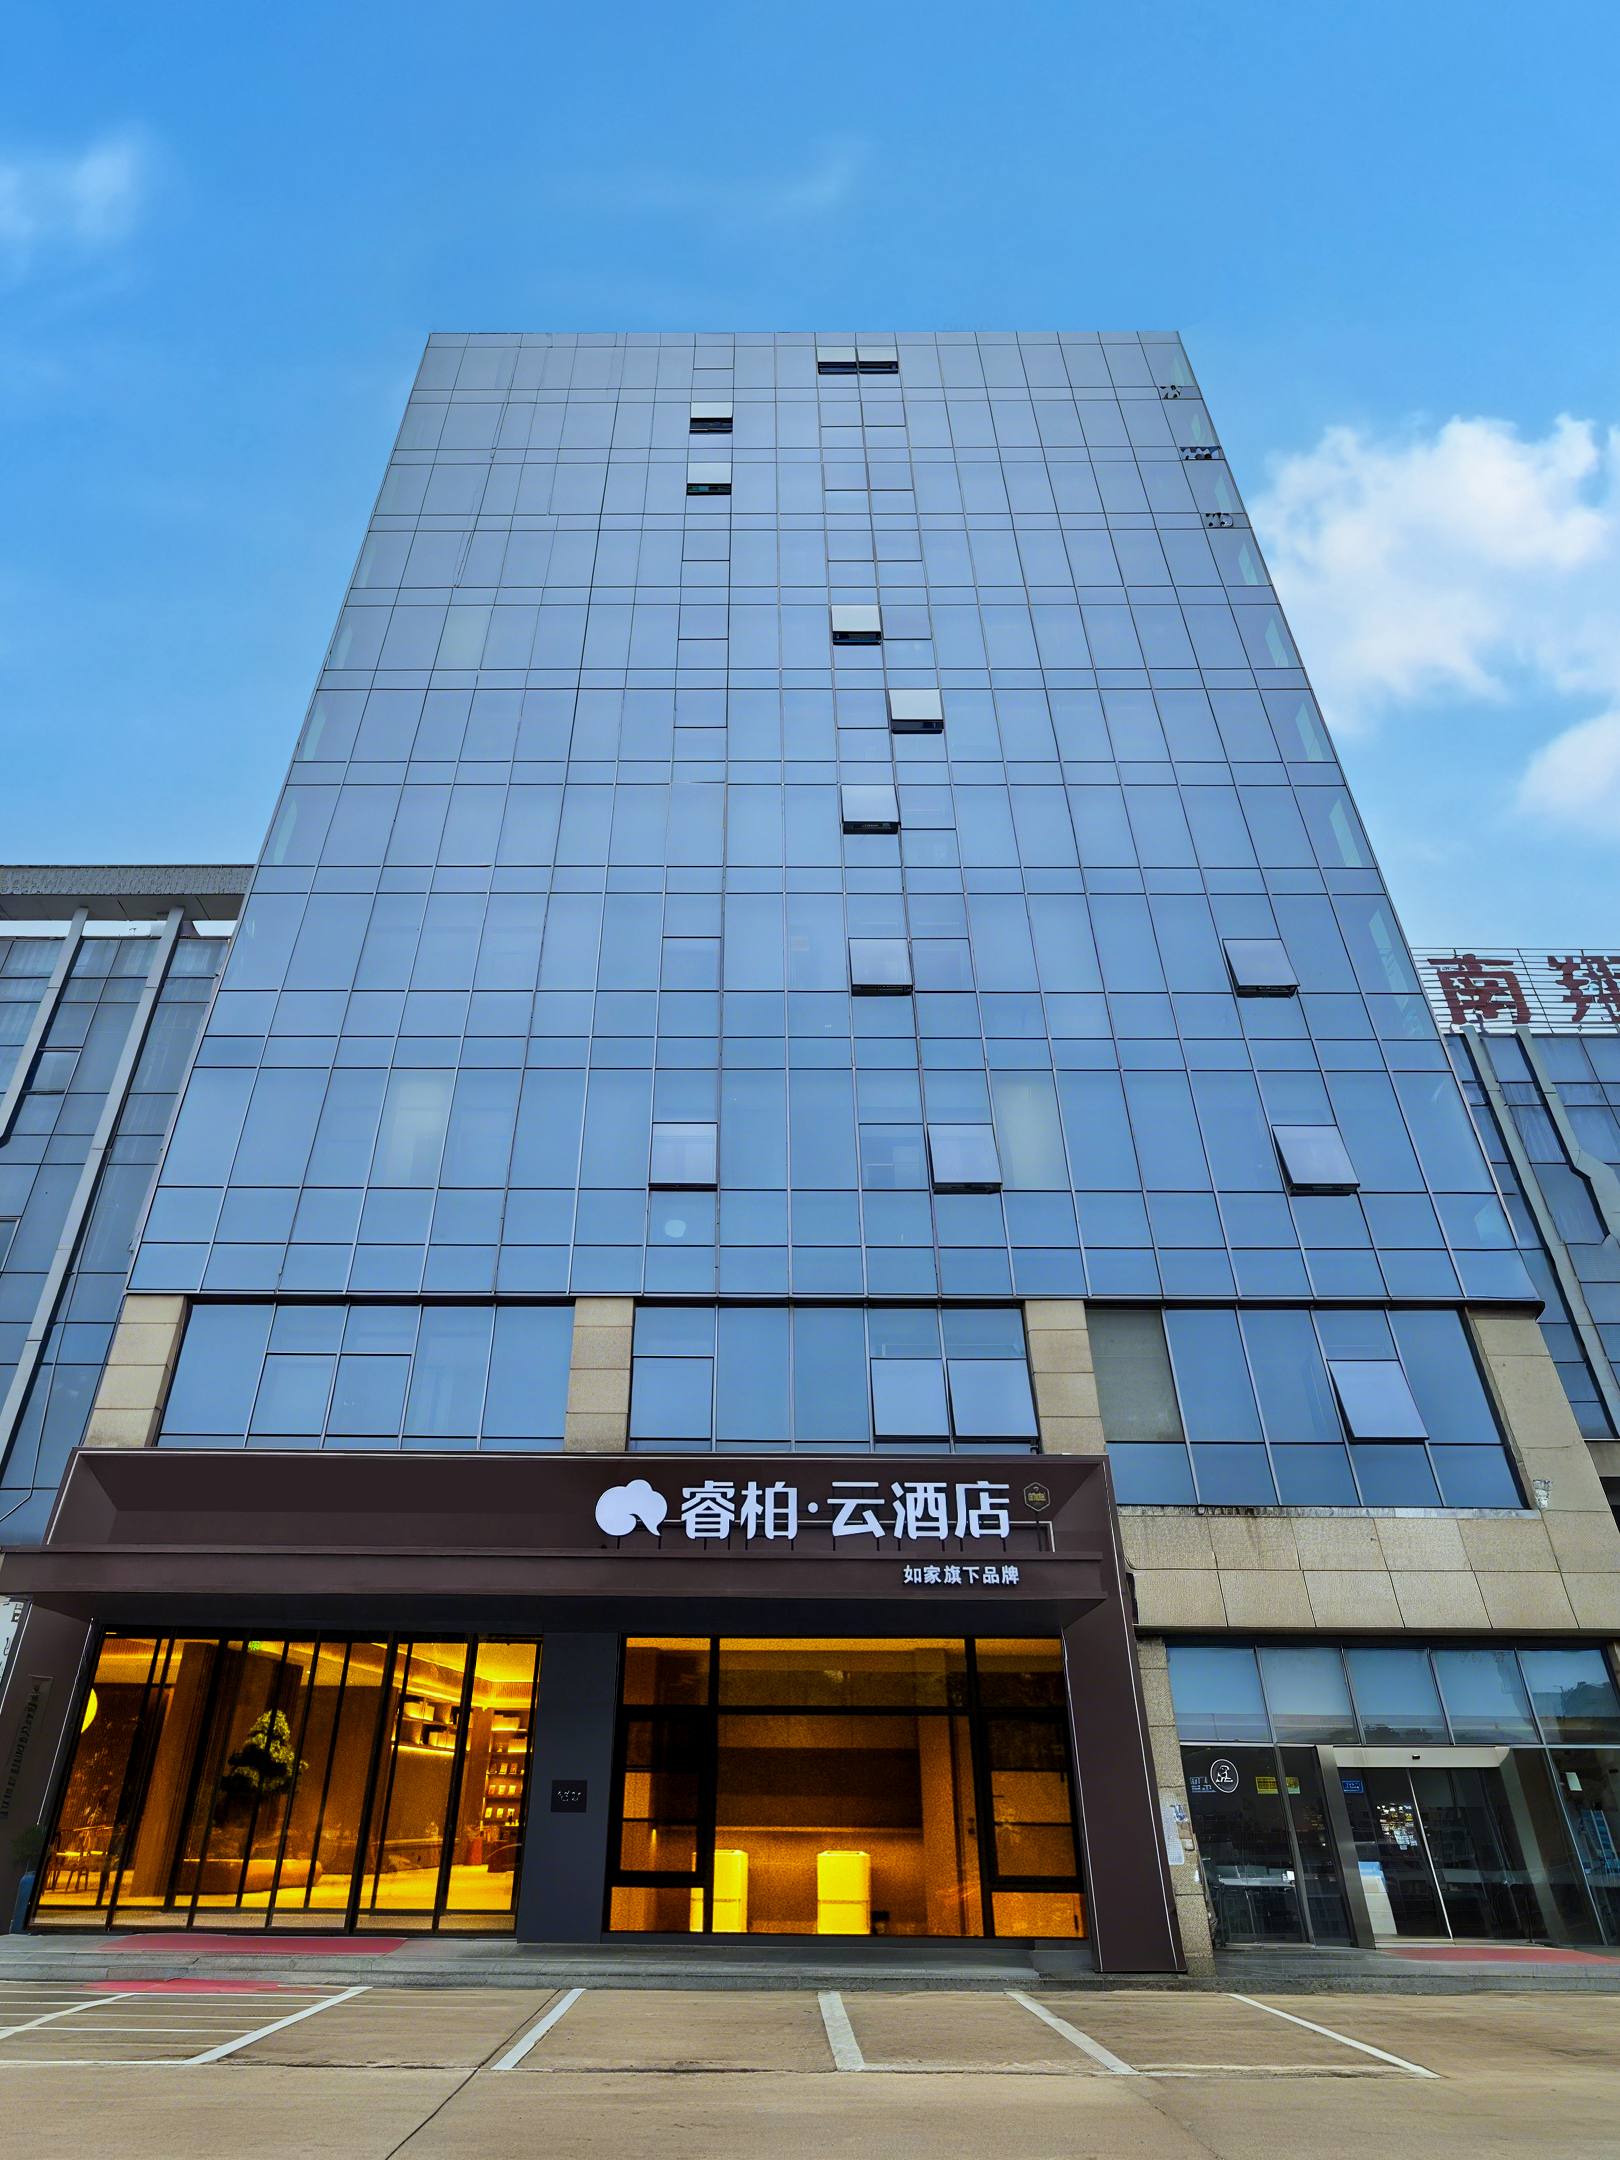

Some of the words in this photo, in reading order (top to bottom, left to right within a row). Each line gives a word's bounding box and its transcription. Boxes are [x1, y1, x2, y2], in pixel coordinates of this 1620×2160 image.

[903, 1564, 1020, 1586] 如家旗下品牌
